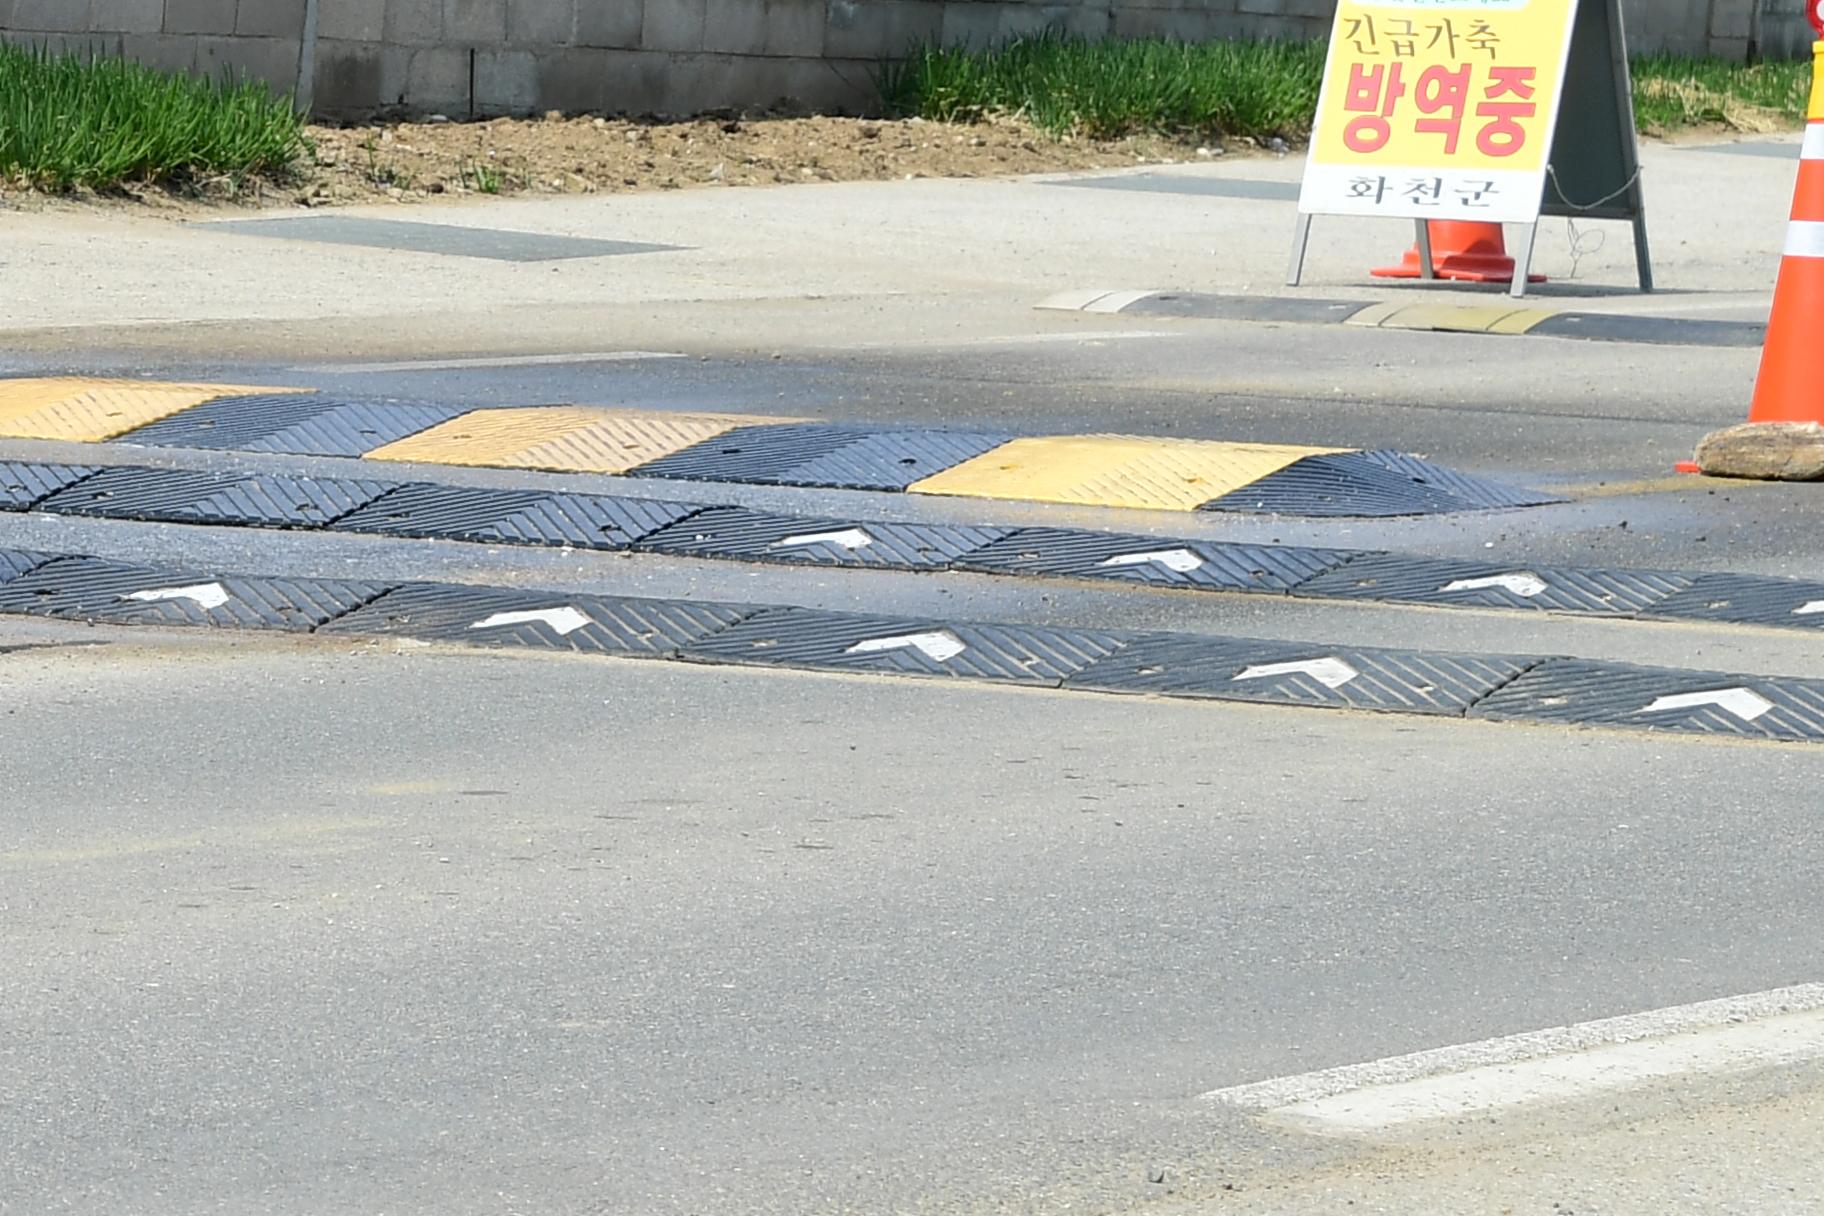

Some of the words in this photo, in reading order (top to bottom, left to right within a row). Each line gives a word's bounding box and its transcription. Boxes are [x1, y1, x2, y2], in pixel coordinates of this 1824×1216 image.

[1343, 13, 1501, 61] 긴급가축
[1342, 62, 1537, 157] 방역중
[1345, 175, 1501, 208] 화천군
